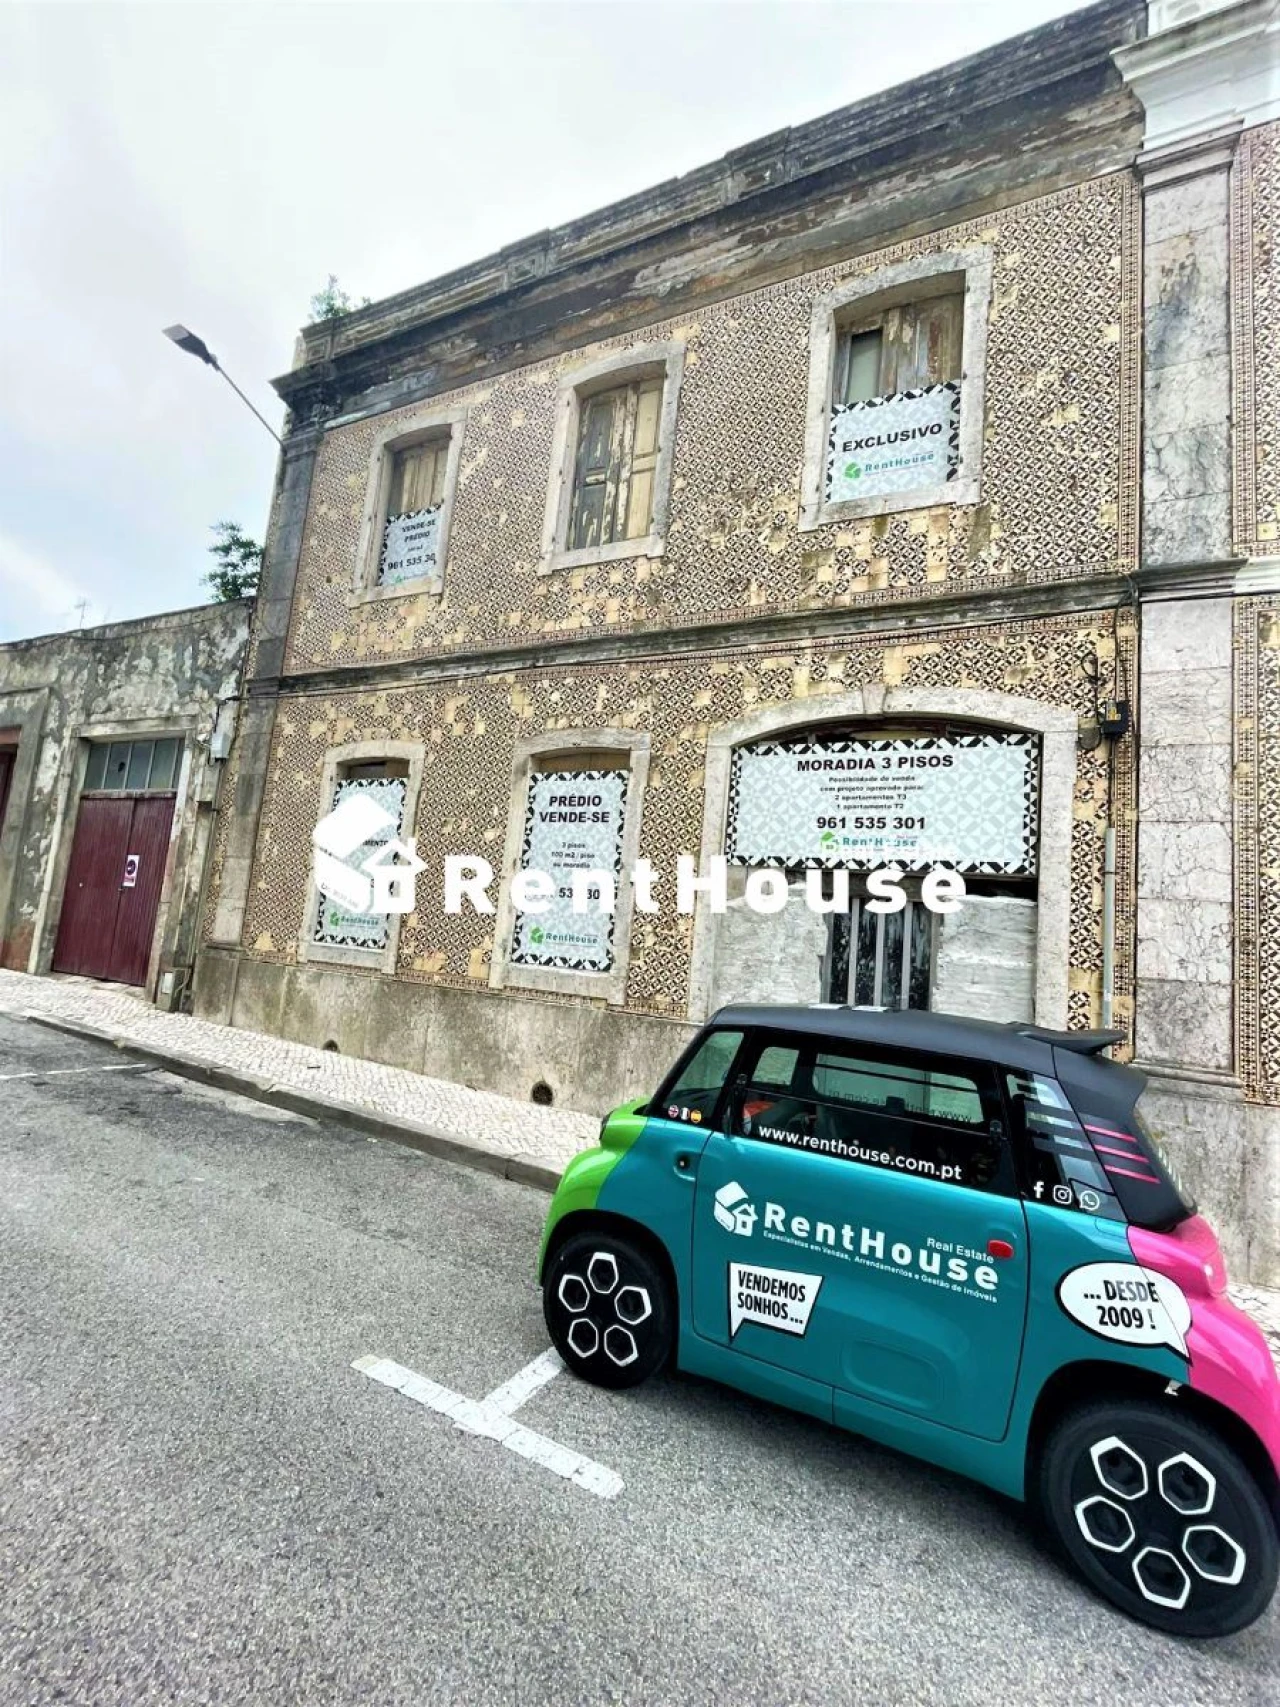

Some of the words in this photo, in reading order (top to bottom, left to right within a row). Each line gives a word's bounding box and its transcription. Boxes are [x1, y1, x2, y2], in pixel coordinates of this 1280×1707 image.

[843, 423, 942, 452] EXCLUSIVO
[865, 453, 934, 472] RentHouse
[402, 519, 435, 532] VENDE-SE
[797, 758, 876, 771] MORADIA
[882, 757, 891, 769] 3
[898, 755, 953, 769] PISOS
[549, 794, 603, 807] PRÉDIO
[539, 811, 610, 823] VENDE-SE
[817, 817, 846, 829] 961
[854, 817, 887, 829] 535
[893, 817, 926, 829] 301
[559, 887, 574, 899] 53
[545, 932, 598, 944] RentHouse
[759, 1126, 962, 1180] www.renthouse.com.pt
[764, 1202, 998, 1290] RentHouse
[927, 1237, 953, 1253] Real
[956, 1244, 994, 1264] Estate
[763, 1229, 808, 1248] Especialistas
[854, 1256, 913, 1278] Arrendamentos
[921, 1274, 950, 1290] Gestão
[951, 1284, 962, 1292] de
[963, 1287, 998, 1303] Imóveis
[738, 1270, 806, 1302] VENDEMOS
[1104, 1280, 1159, 1302] DESDE
[1096, 1306, 1144, 1329] 2009
